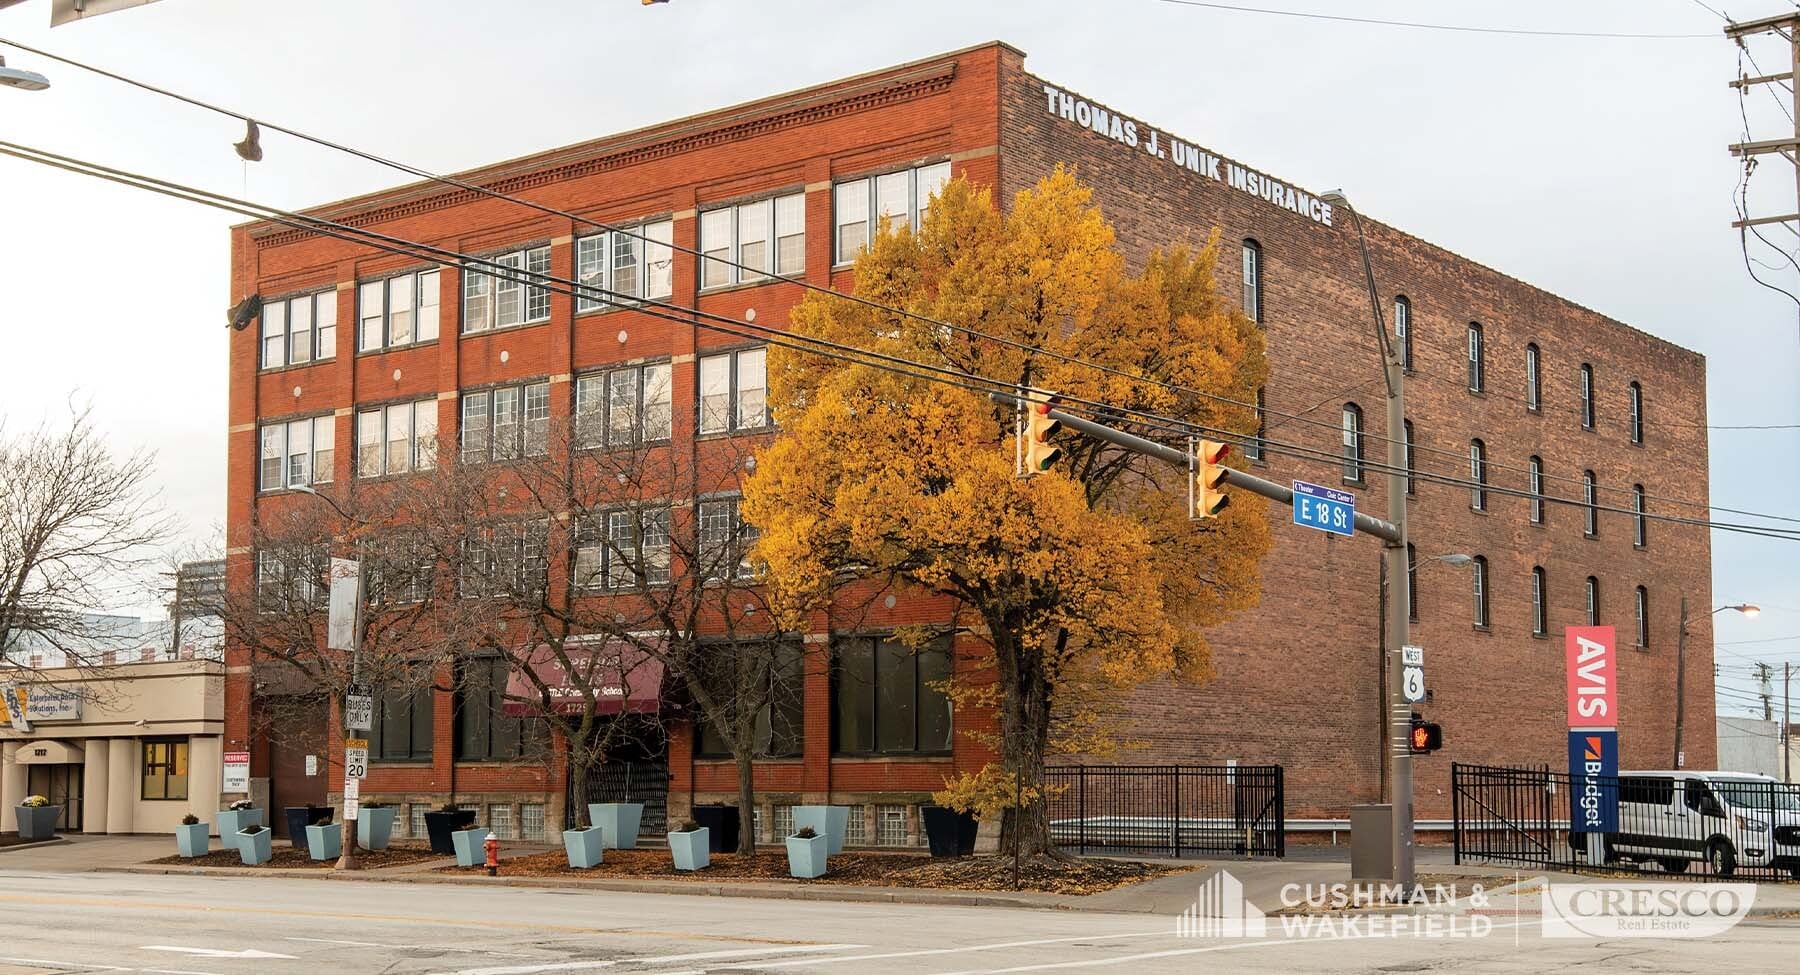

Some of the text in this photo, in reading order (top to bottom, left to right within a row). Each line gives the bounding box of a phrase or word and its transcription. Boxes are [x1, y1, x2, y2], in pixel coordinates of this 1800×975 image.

[1044, 86, 1333, 227] THOMAS J. UNIK INSURANCE
[1316, 503, 1329, 524] 18
[1333, 506, 1347, 528] St
[1405, 648, 1420, 661] WEST
[1409, 673, 1418, 694] 6
[1577, 636, 1607, 717] AVIS
[348, 699, 371, 710] BUSES
[349, 710, 369, 723] ONLY
[348, 749, 365, 757] SPEED
[348, 764, 364, 777] 20
[1580, 761, 1602, 827] Budget
